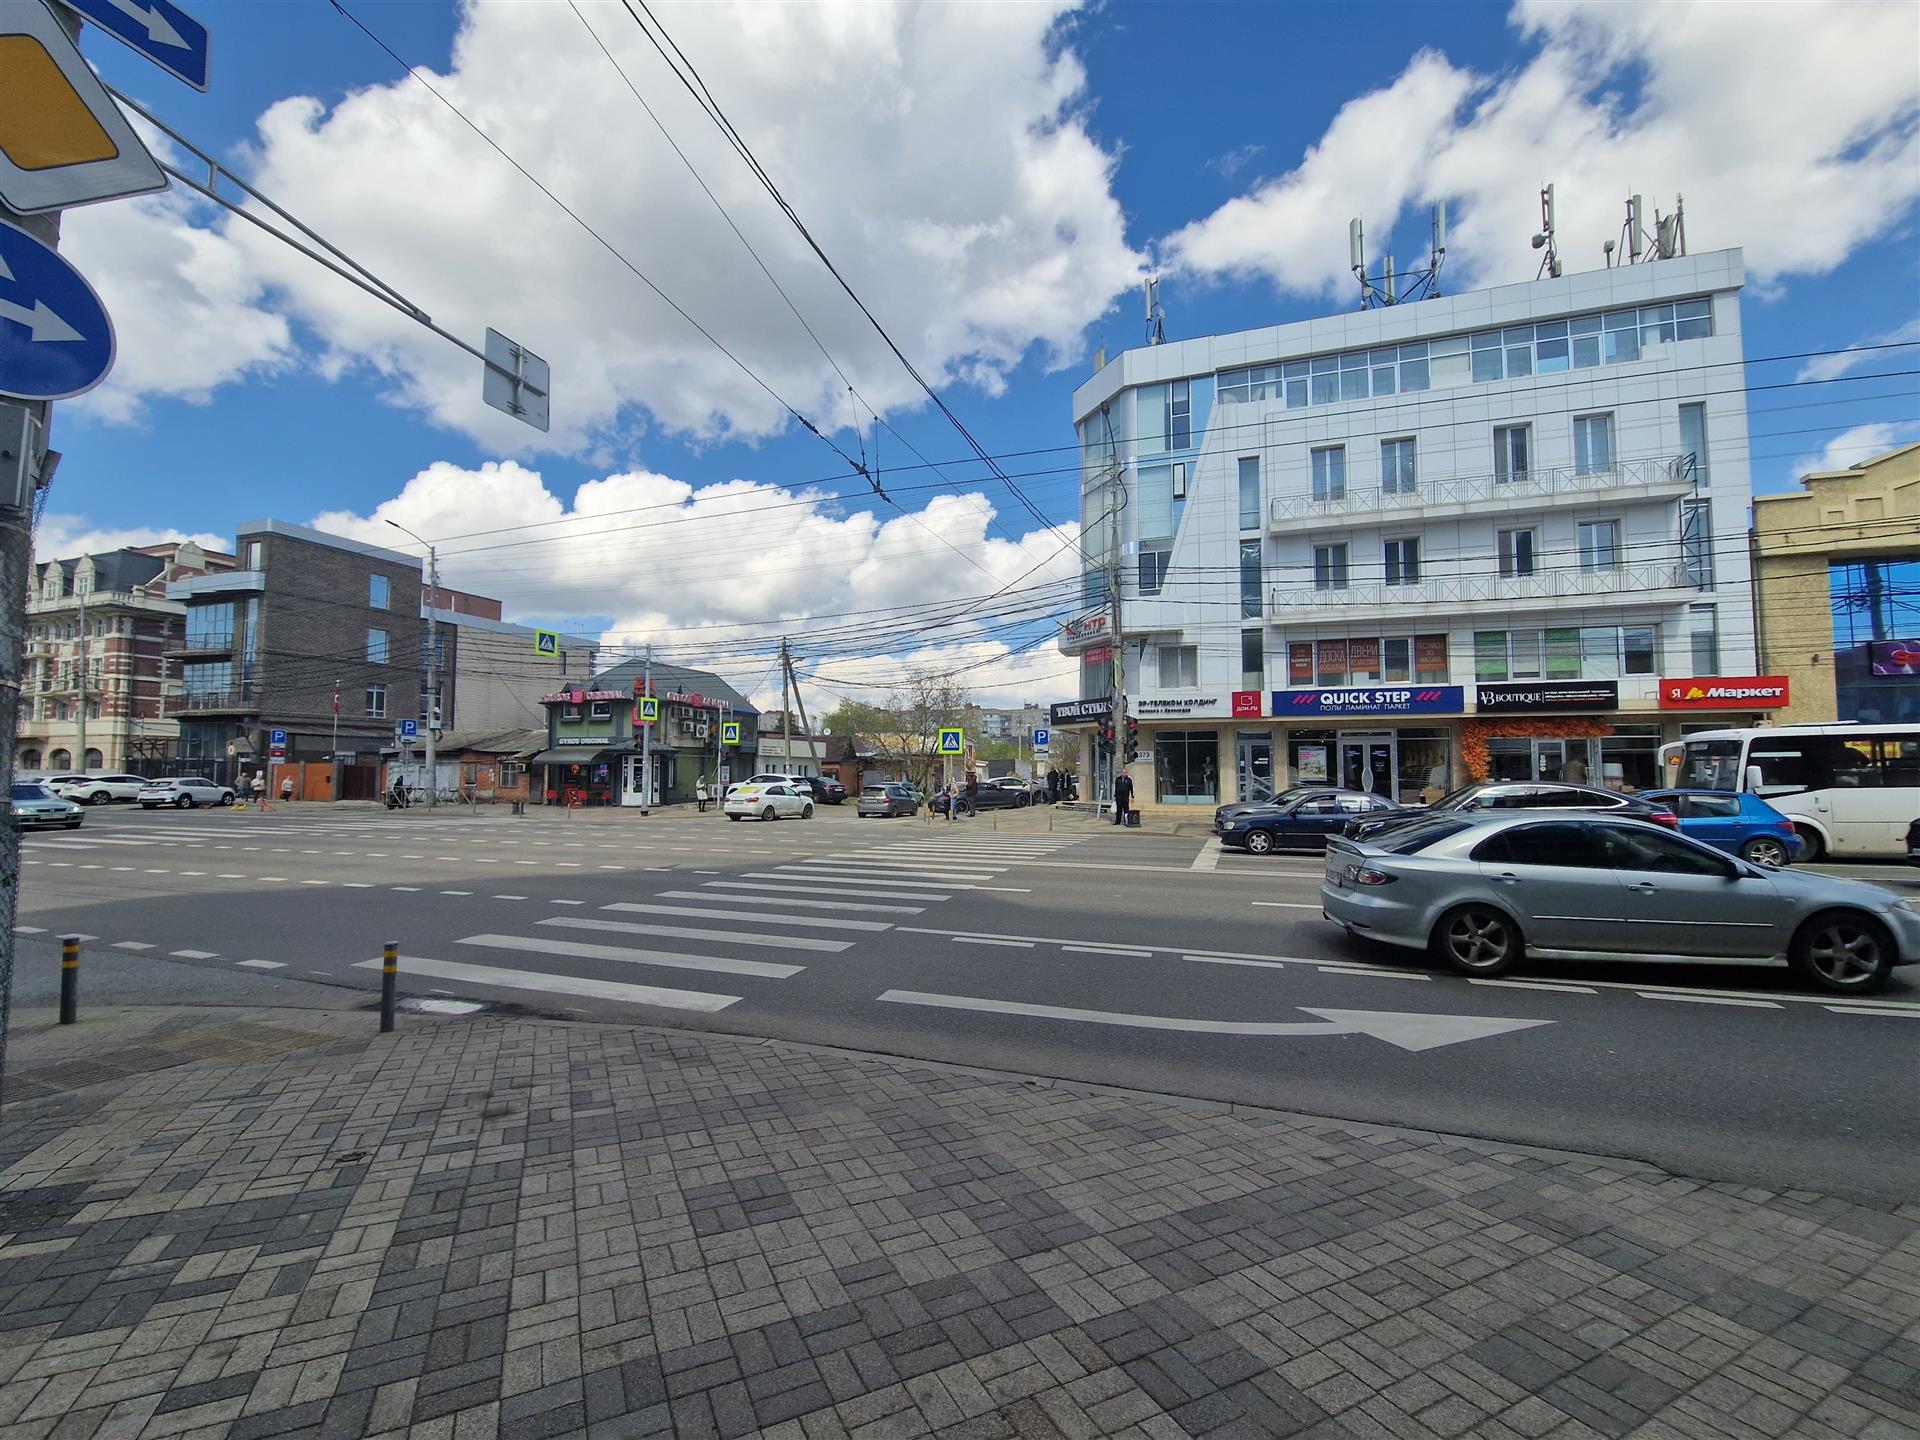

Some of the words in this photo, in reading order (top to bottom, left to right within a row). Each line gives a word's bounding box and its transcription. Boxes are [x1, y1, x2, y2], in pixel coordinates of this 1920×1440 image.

[1351, 645, 1378, 658] ДВЕРИ
[1320, 692, 1370, 705] QUICK
[1375, 691, 1411, 704] STEP
[1495, 692, 1541, 703] BOUTIQUE
[1672, 688, 1681, 698] Я
[1706, 687, 1784, 699] Маркет
[1138, 699, 1183, 707] ЭР-ТЕЛЕКОМ
[1184, 698, 1218, 706] ХОЛДИНГ
[1056, 703, 1080, 717] ТВОЙ
[405, 721, 415, 733] P
[274, 731, 283, 741] P
[1037, 731, 1046, 743] P
